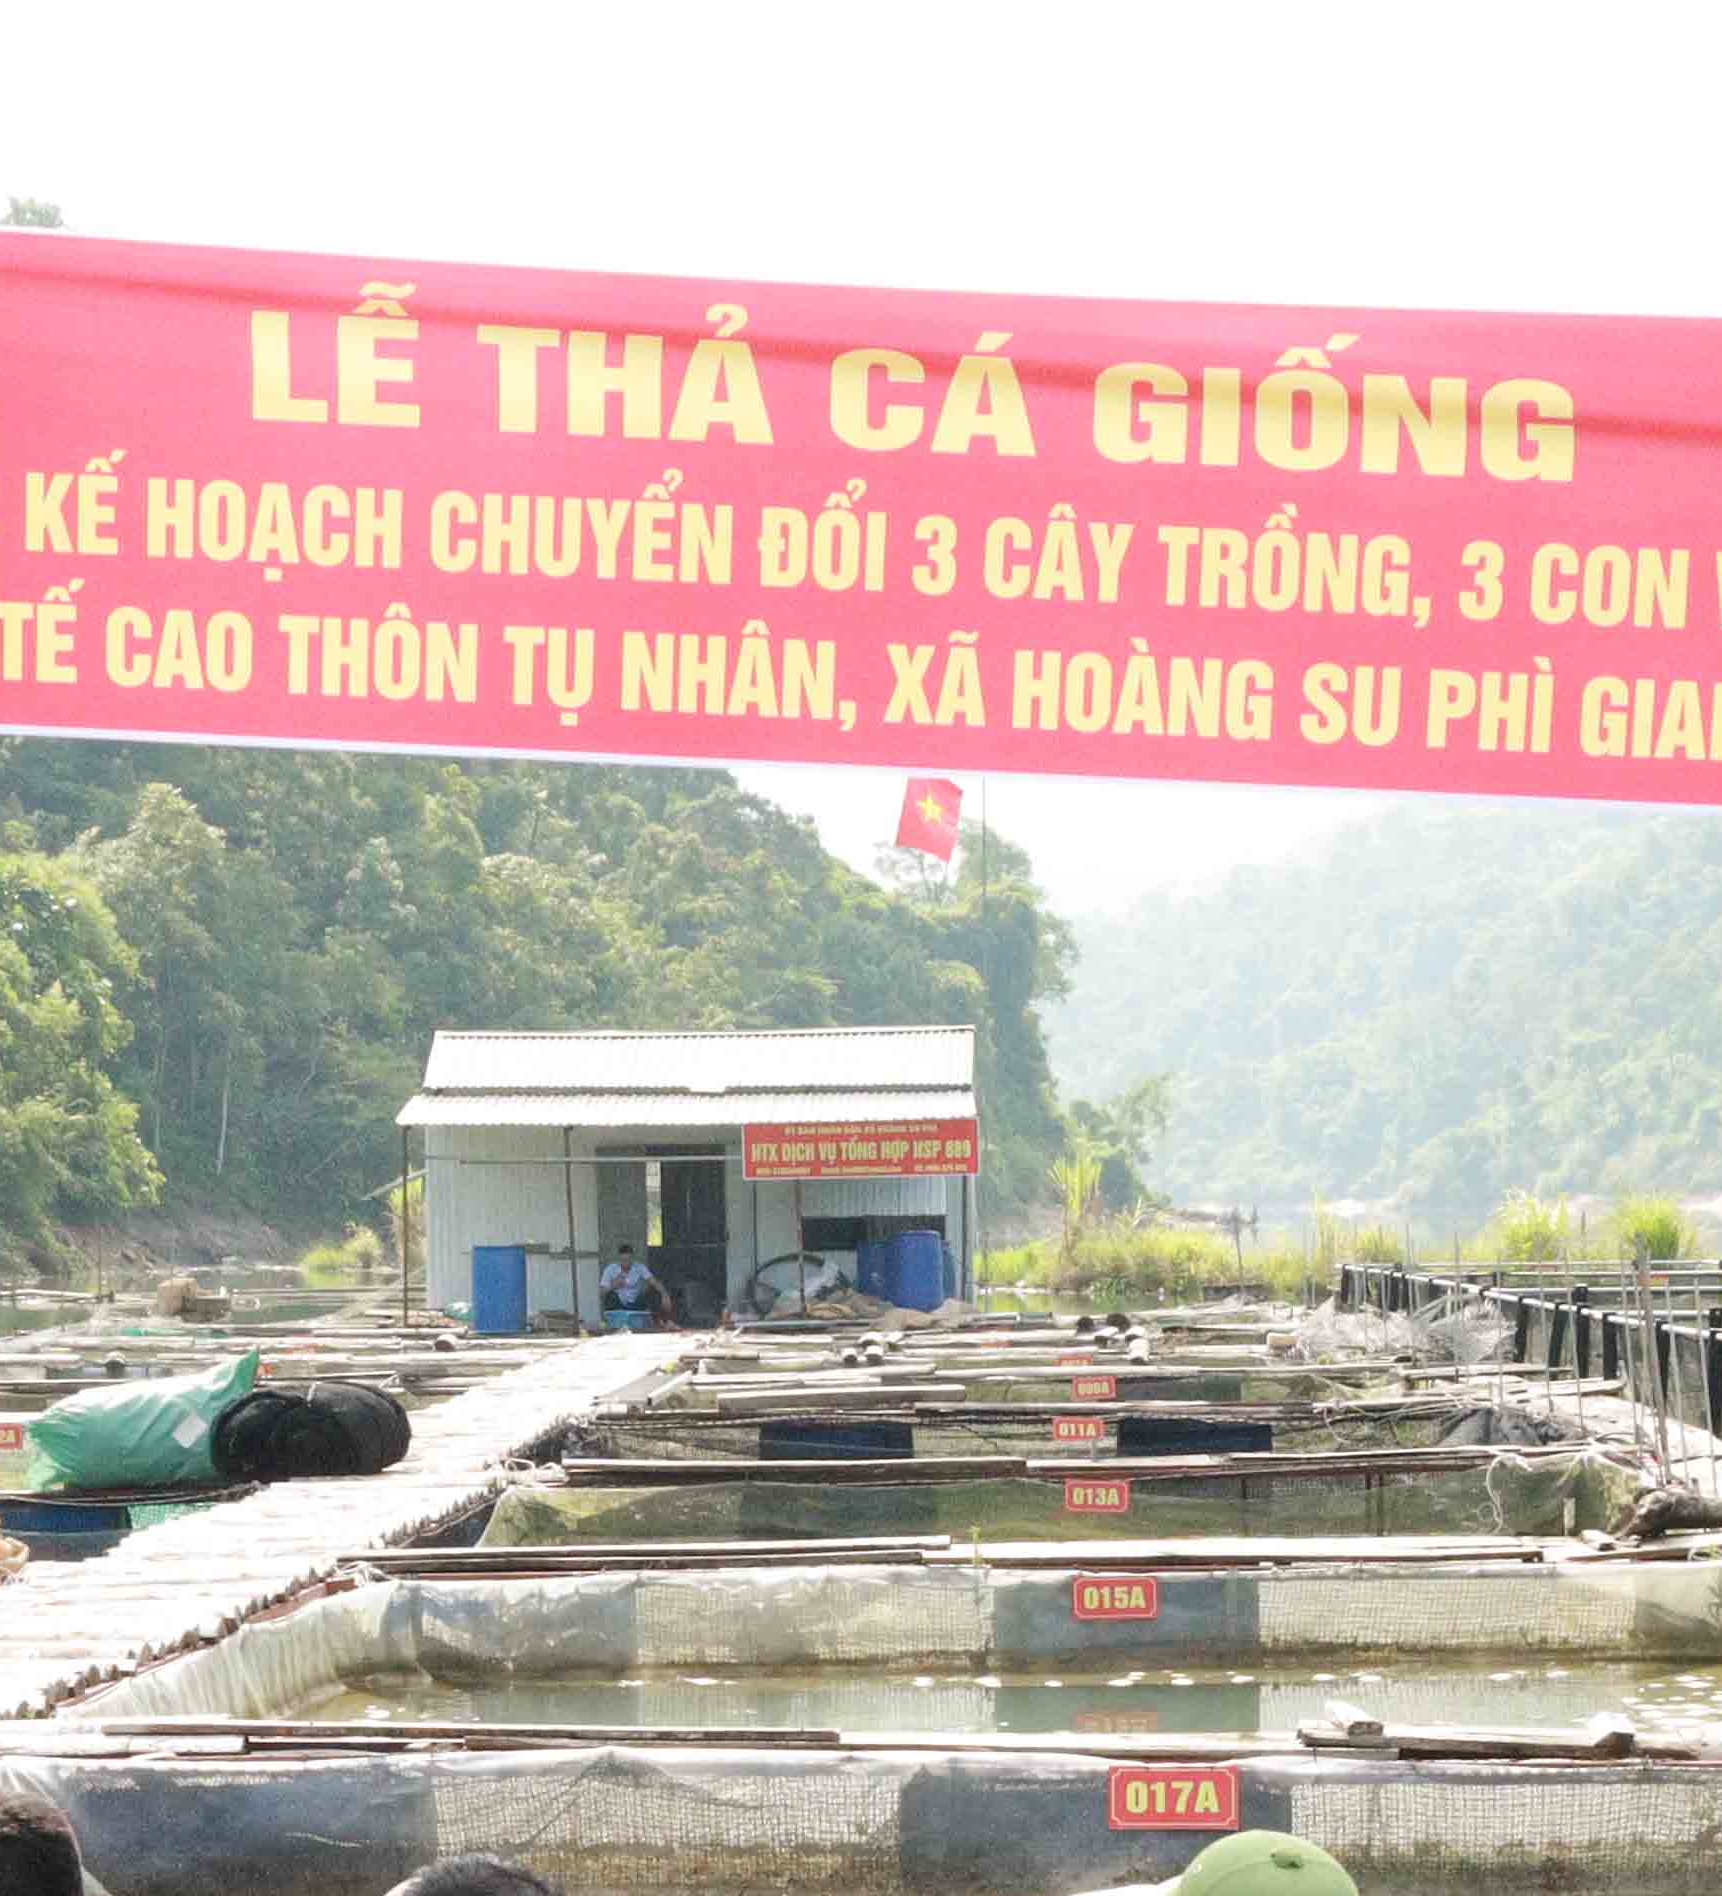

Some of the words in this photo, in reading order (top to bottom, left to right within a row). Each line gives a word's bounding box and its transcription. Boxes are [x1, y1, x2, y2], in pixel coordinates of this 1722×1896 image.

[250, 282, 423, 426] LỄ
[477, 302, 775, 444] THẢ
[829, 333, 1038, 458] CÁ
[1092, 334, 1577, 482] GIỐNG
[24, 448, 125, 554] KẾ
[146, 478, 406, 581] HOẠCH
[429, 468, 734, 586] CHUYỂN
[756, 480, 888, 593] ĐỔI
[911, 514, 959, 596] 3
[983, 504, 1134, 603] CÂY
[1156, 504, 1432, 624] TRỒNG,
[1458, 539, 1506, 621] 3
[1530, 542, 1692, 630] CON
[105, 606, 254, 693] CAO
[276, 602, 479, 704] THÔN
[502, 623, 596, 725] TỤ
[620, 619, 858, 731] NHÂN,
[884, 630, 986, 726] XÃ
[1011, 638, 1275, 739] HOÀNG
[1299, 662, 1403, 746] SU
[1426, 655, 1556, 754] PHÌ
[1059, 1423, 1097, 1436] 011A
[1072, 1488, 1121, 1505] 013A
[1083, 1585, 1146, 1609] 015A
[1125, 1780, 1221, 1814] 017A
